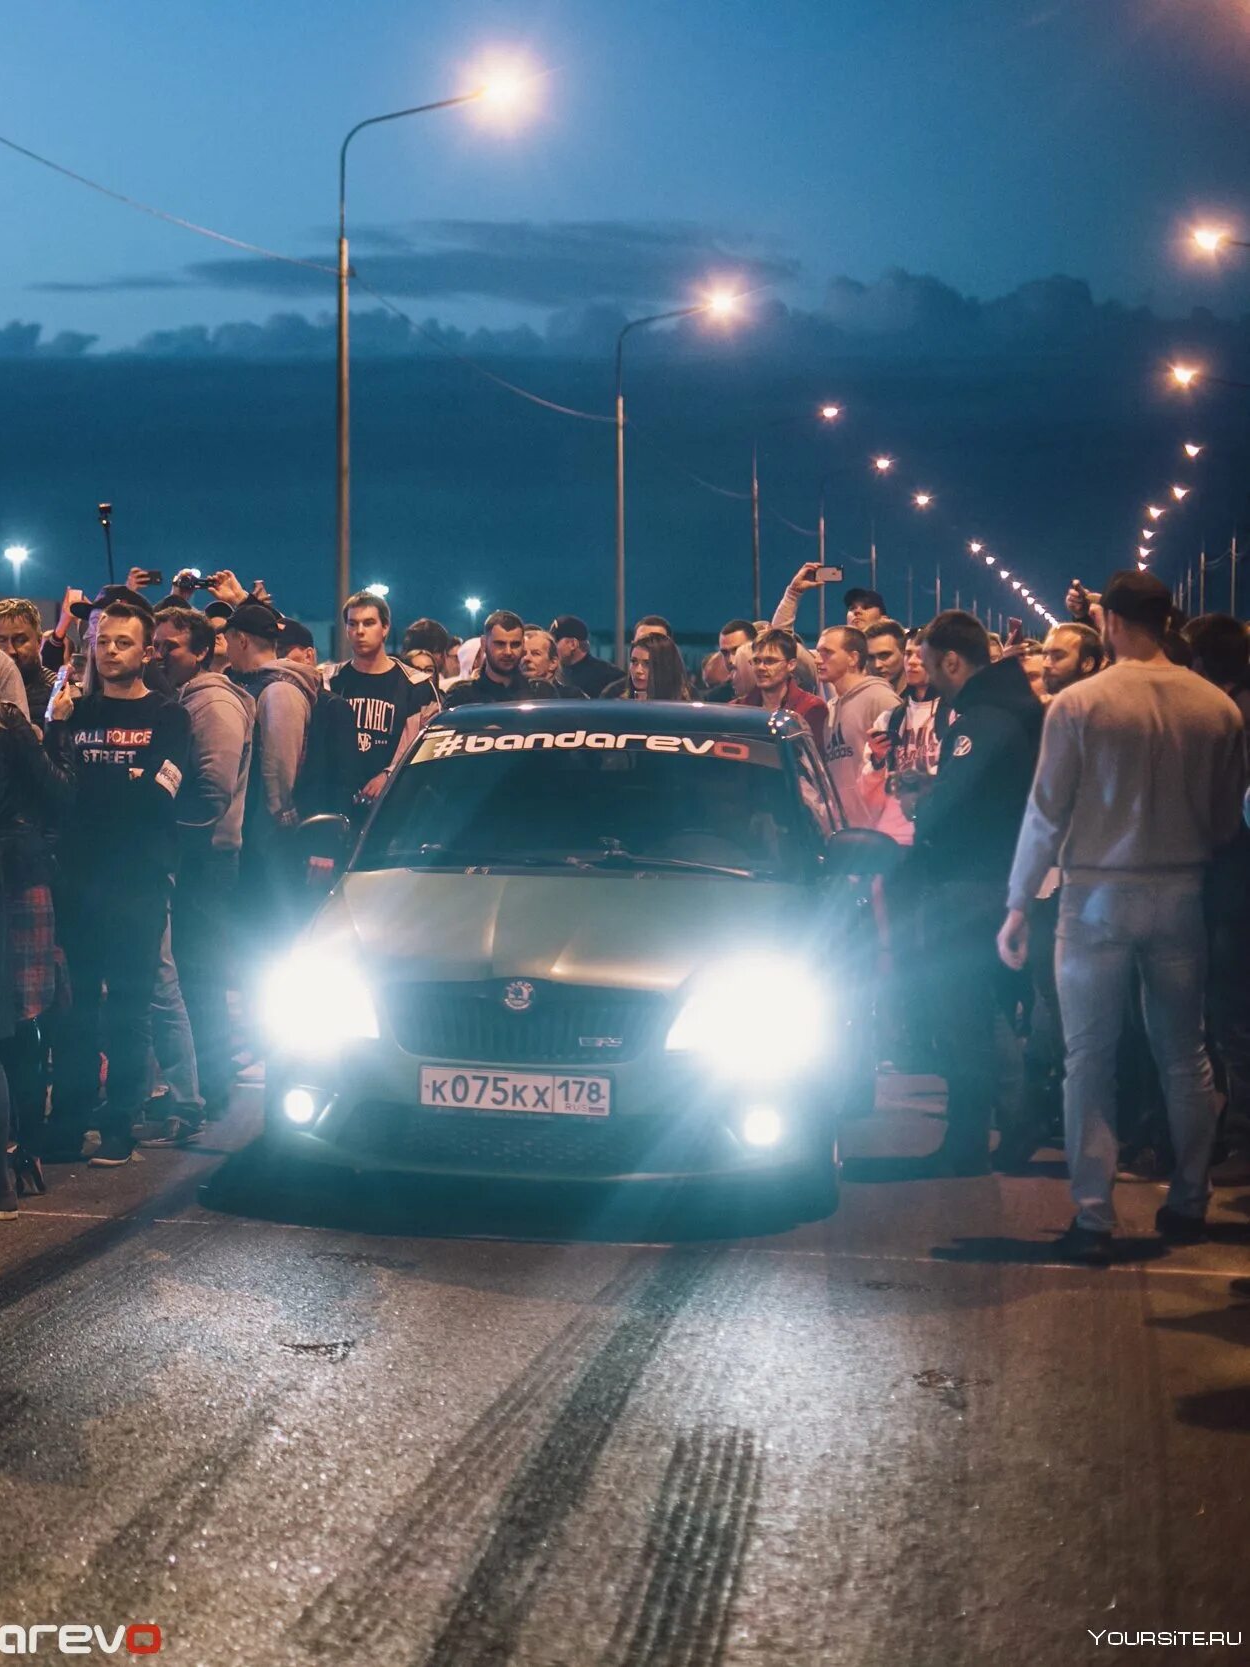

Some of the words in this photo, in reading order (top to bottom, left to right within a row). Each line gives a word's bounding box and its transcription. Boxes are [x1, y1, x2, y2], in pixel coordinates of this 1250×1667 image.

[433, 730, 749, 760] #bandarevo
[557, 1079, 601, 1104] 178
[565, 1102, 588, 1112] RUS
